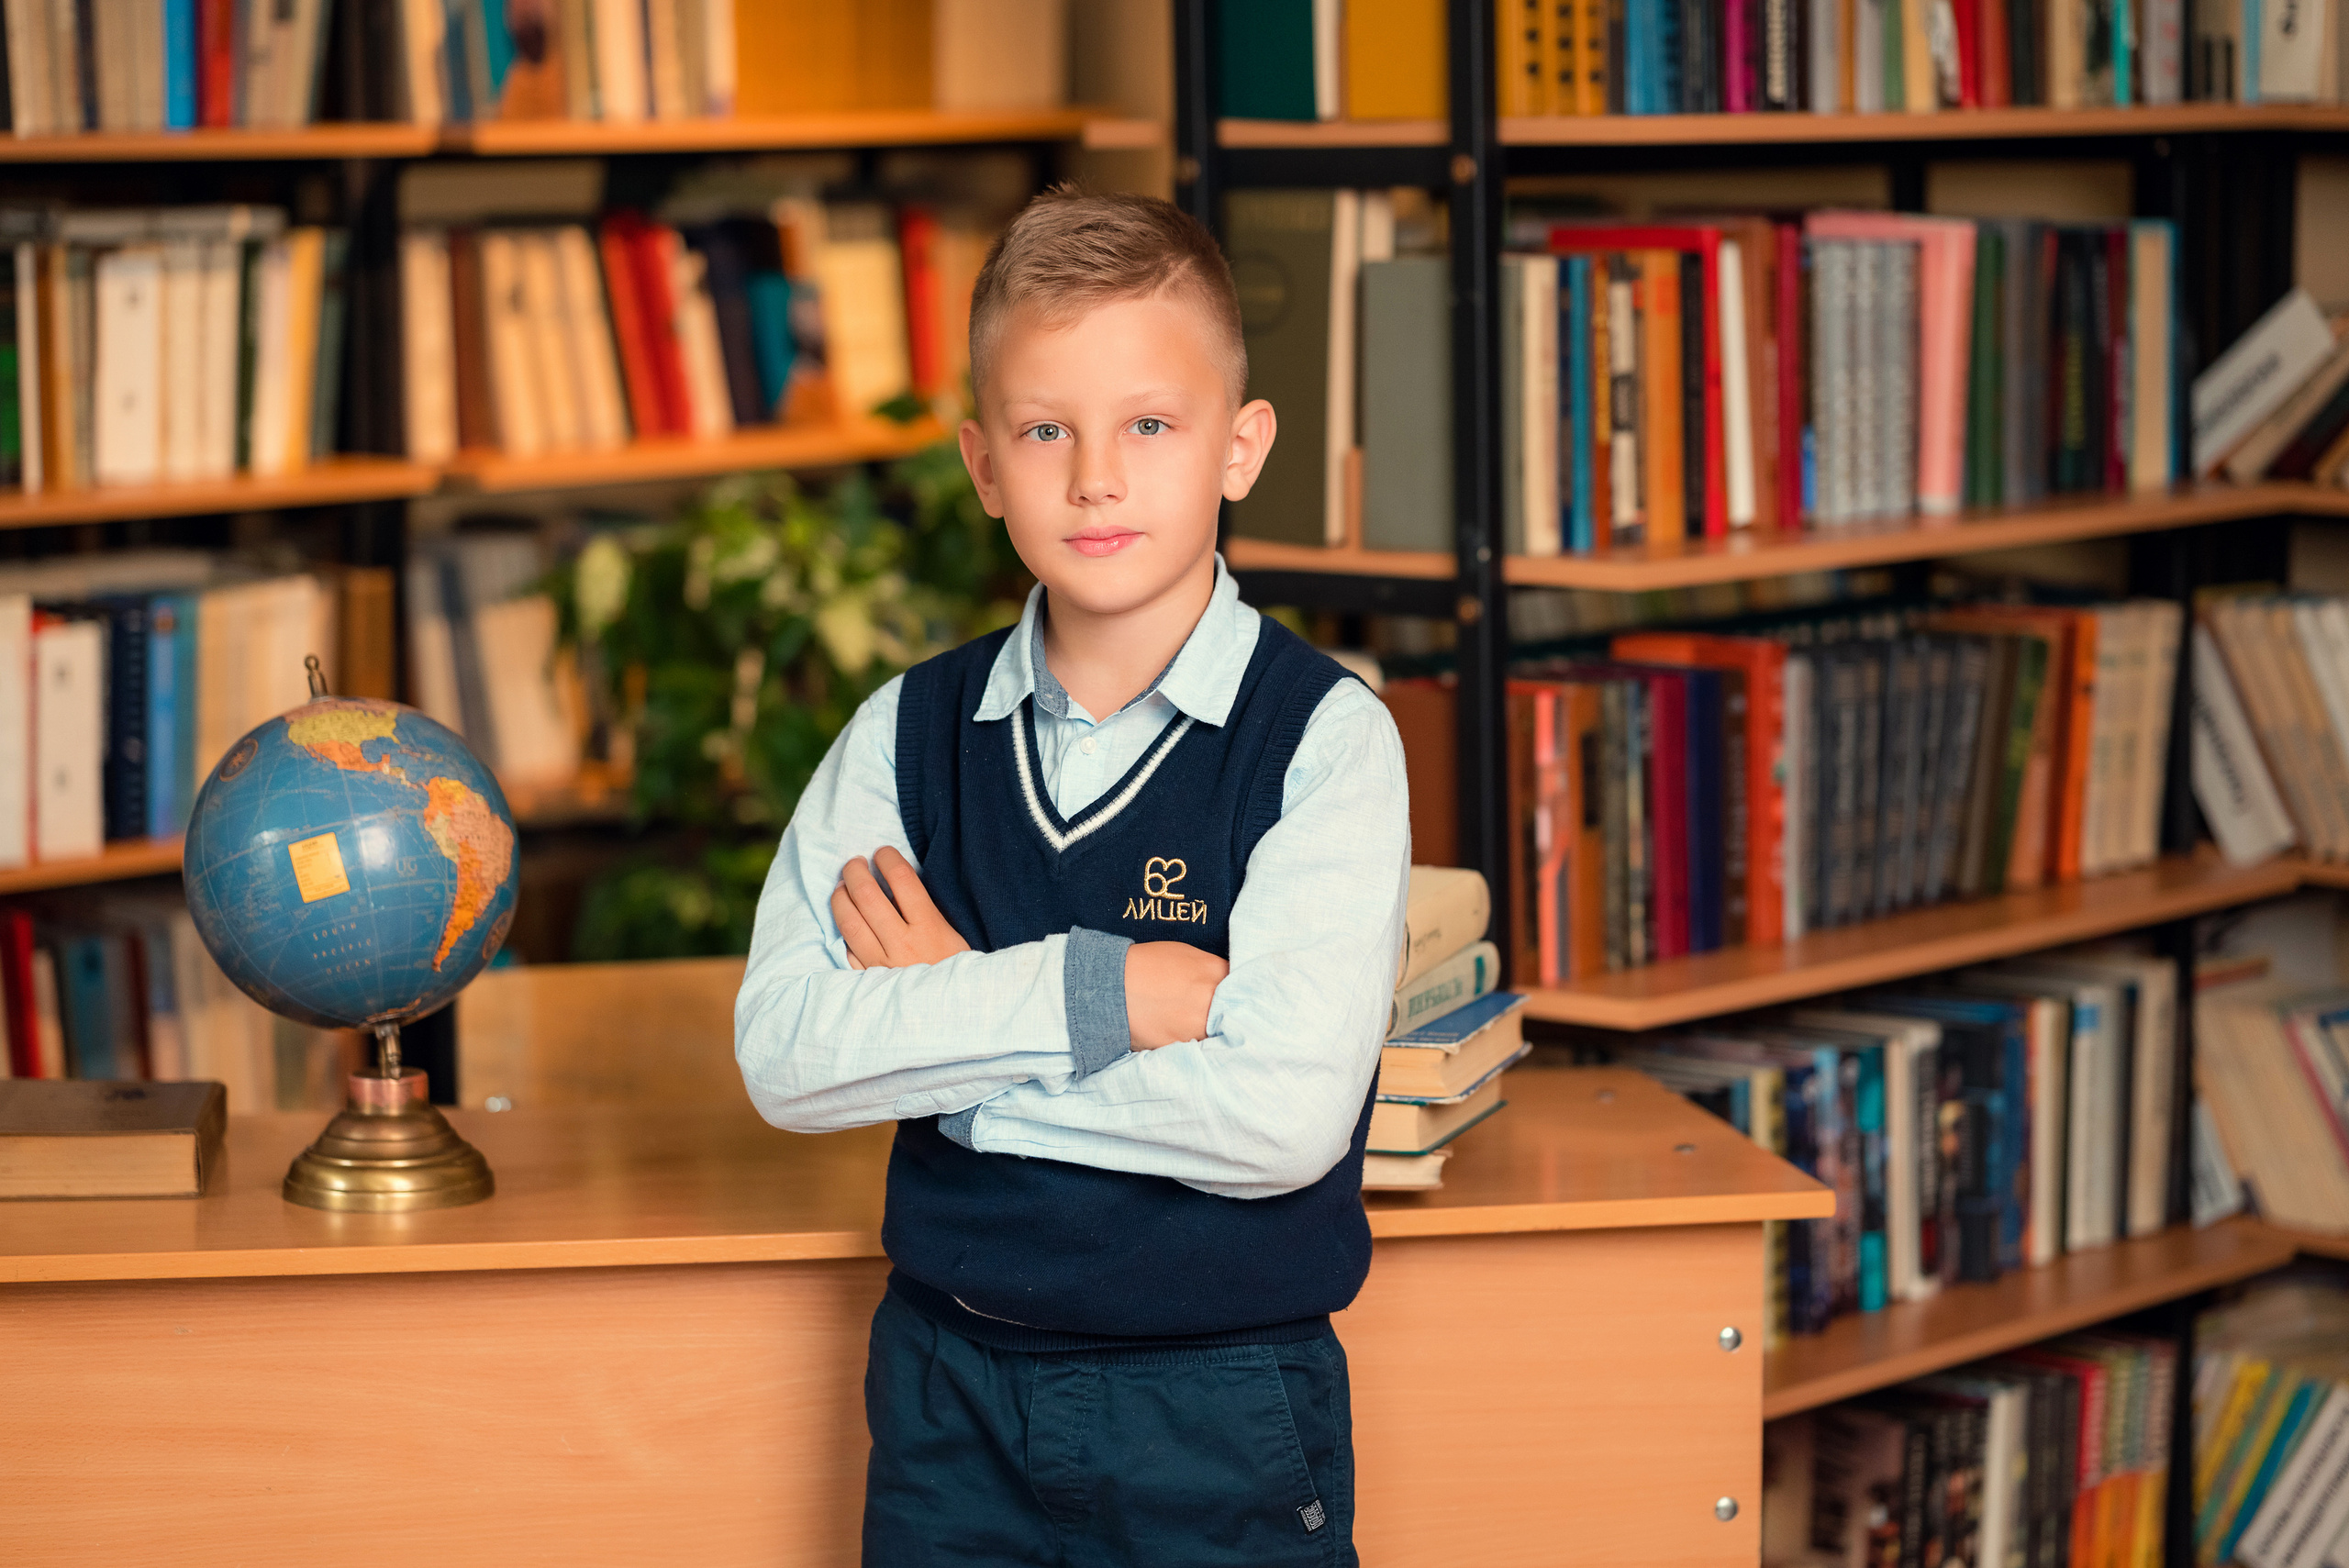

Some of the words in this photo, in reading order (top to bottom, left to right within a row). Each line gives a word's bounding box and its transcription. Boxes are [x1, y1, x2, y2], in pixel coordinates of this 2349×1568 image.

[1144, 856, 1186, 899] 62
[1122, 897, 1208, 925] ЛИЦЕЙ
[313, 921, 356, 941] SOUTH
